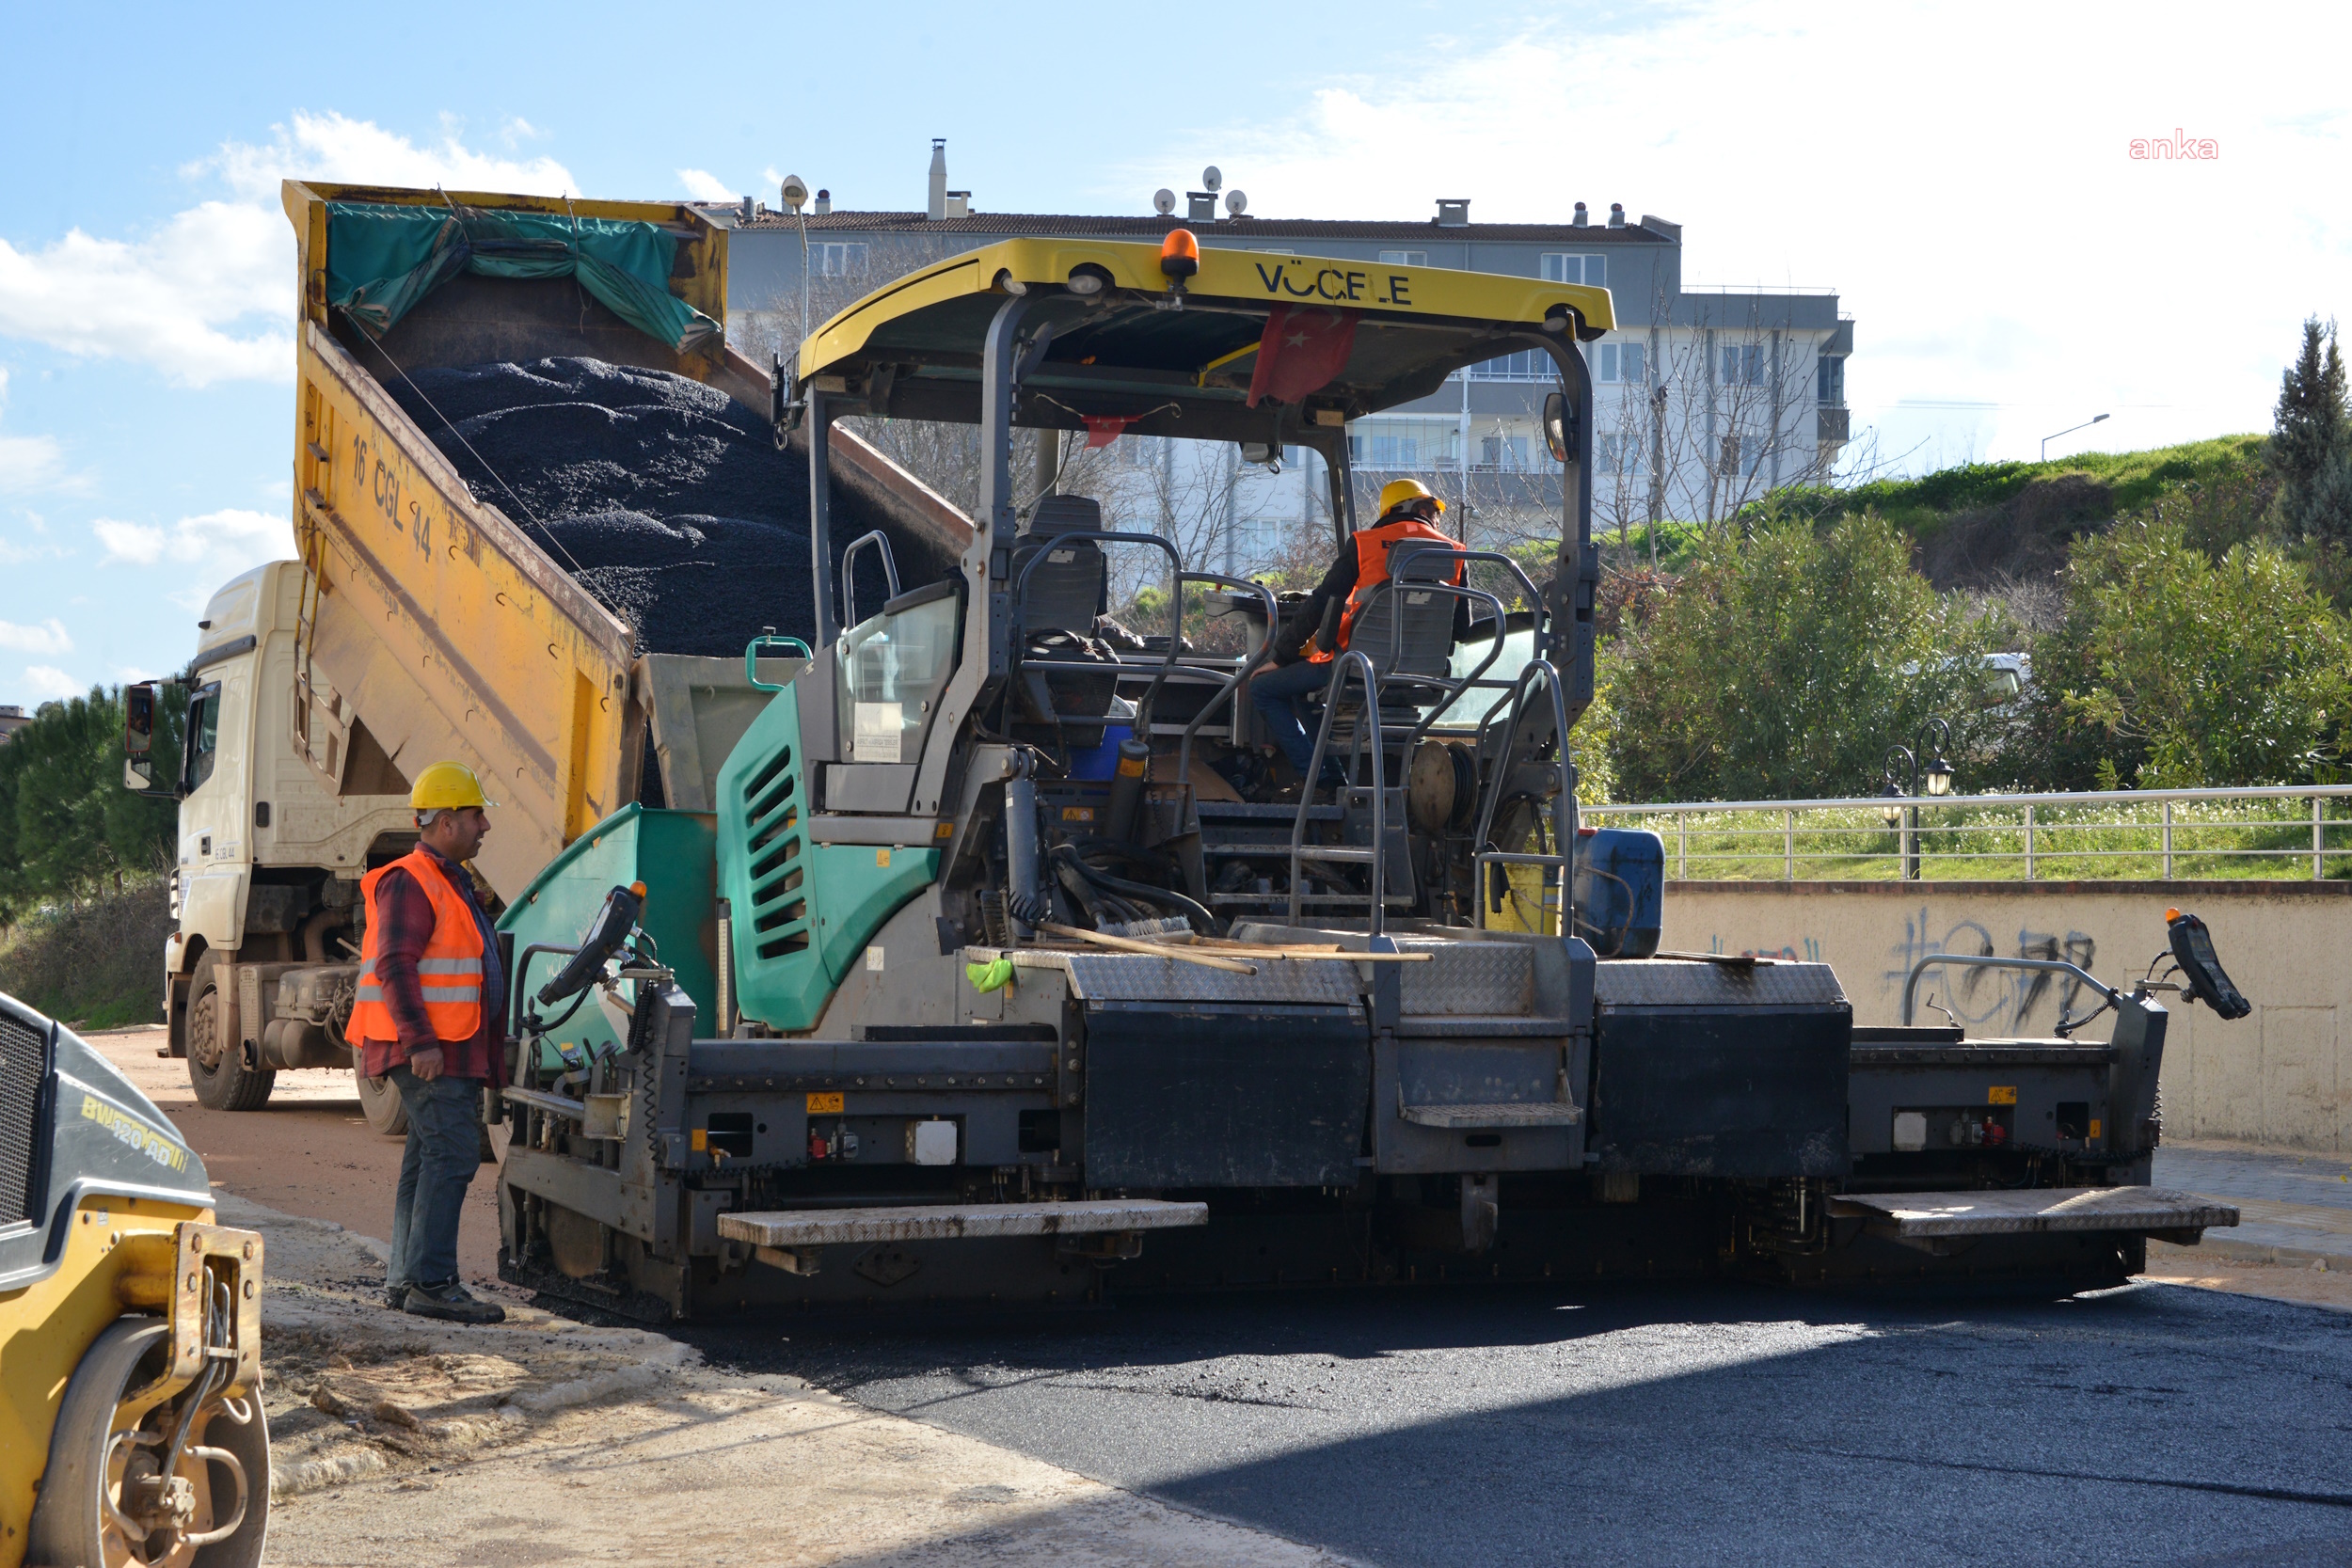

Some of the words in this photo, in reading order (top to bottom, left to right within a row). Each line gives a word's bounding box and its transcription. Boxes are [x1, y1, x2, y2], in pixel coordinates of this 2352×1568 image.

[353, 434, 367, 487] 16
[373, 459, 404, 533] CGL
[413, 505, 432, 564] 44
[81, 1094, 116, 1132] BW
[113, 1118, 143, 1150] 120
[145, 1139, 170, 1167] AD
